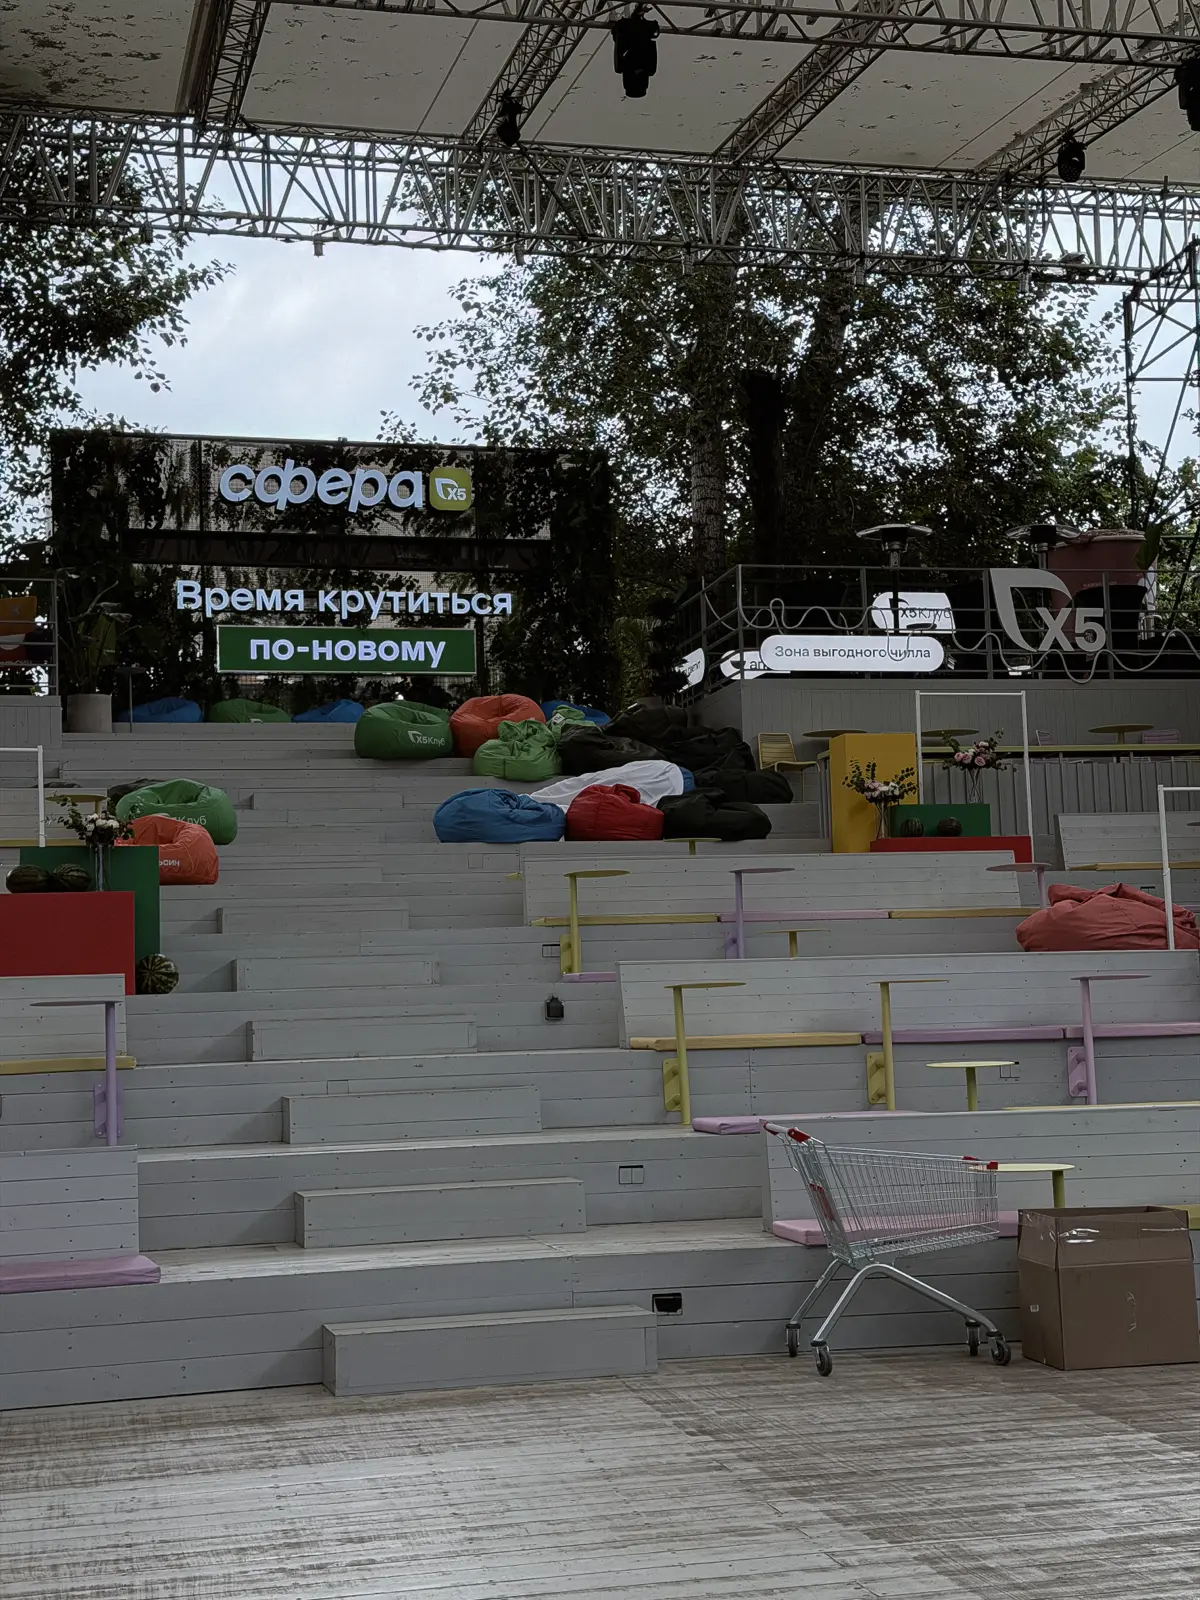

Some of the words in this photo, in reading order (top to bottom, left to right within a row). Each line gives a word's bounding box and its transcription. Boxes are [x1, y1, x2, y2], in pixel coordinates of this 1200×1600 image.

[220, 459, 423, 513] сфера
[446, 487, 467, 501] X5
[176, 580, 304, 618] Время
[319, 589, 512, 620] крутиться
[1035, 607, 1106, 652] X5
[250, 639, 446, 669] по-новому
[774, 646, 810, 659] Зона
[813, 647, 886, 661] выгодного
[890, 648, 931, 659] чилла
[159, 859, 180, 867] ьсин
